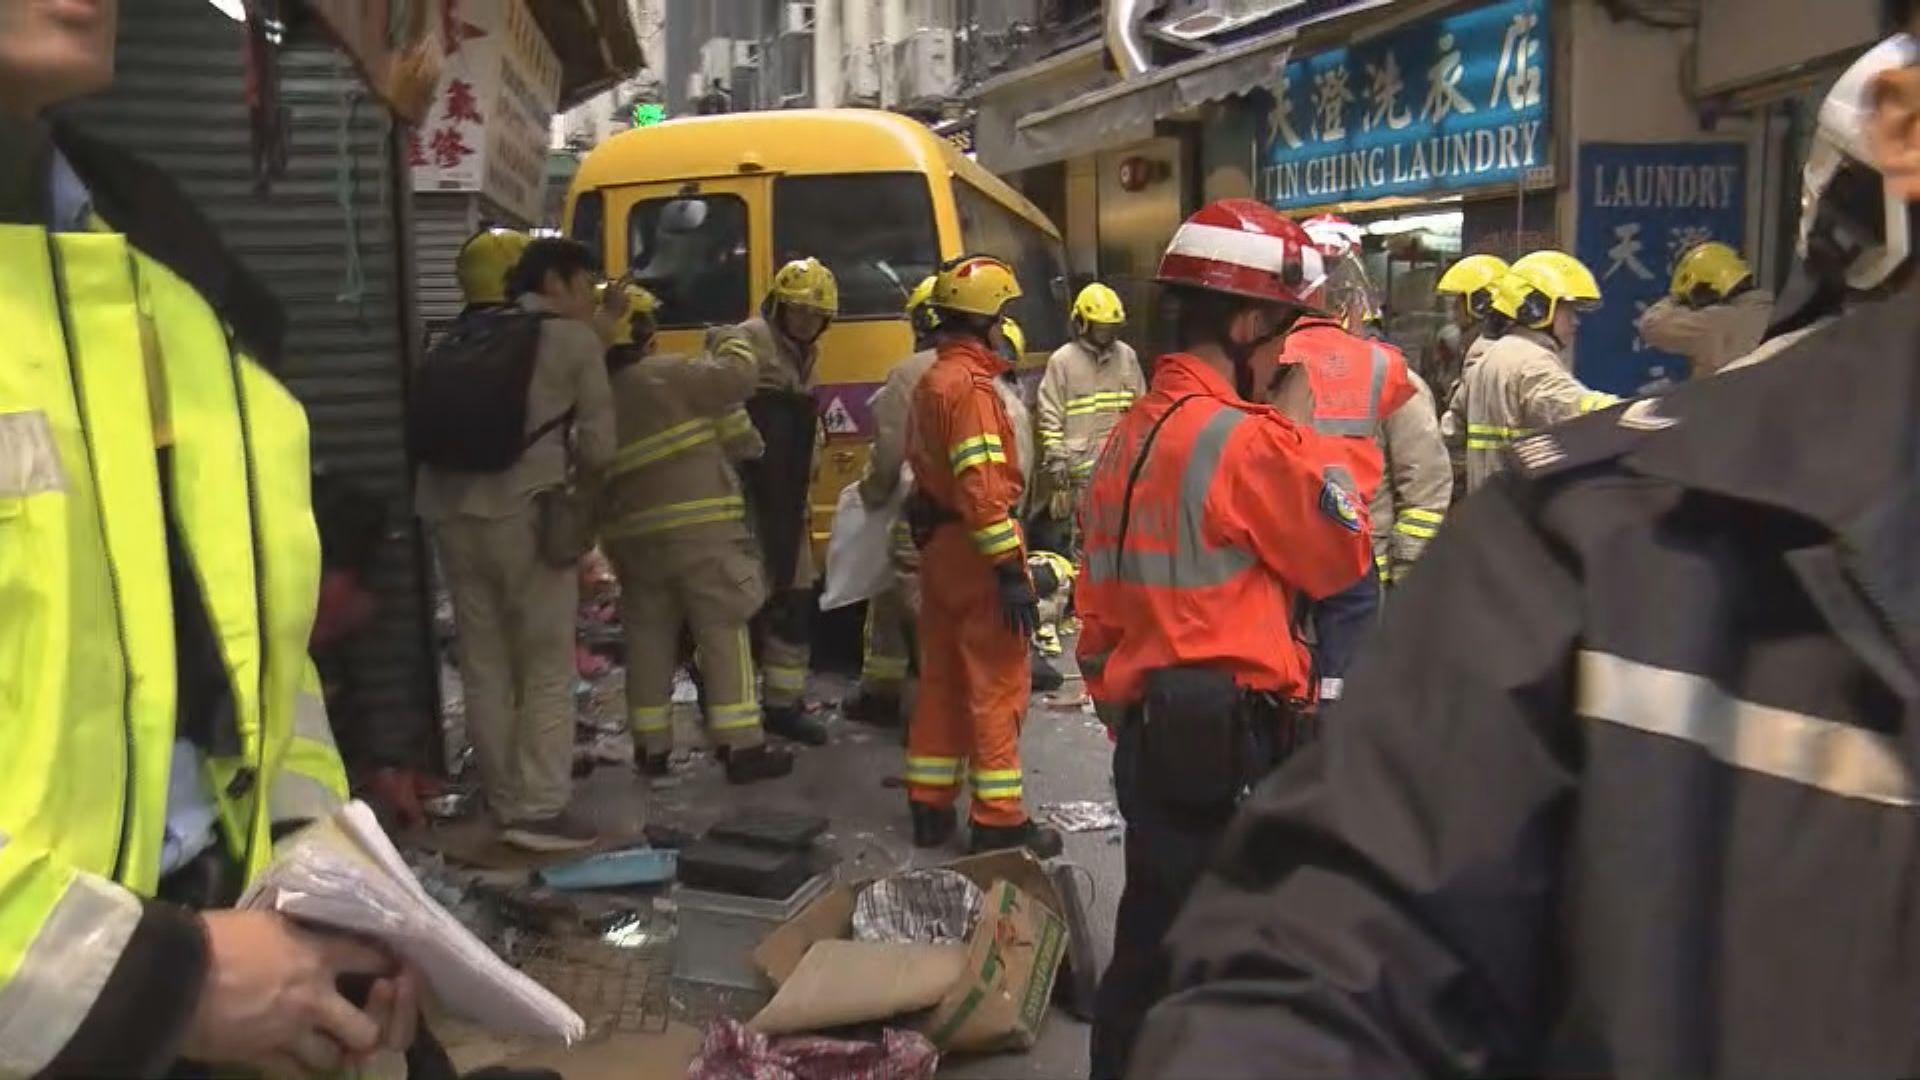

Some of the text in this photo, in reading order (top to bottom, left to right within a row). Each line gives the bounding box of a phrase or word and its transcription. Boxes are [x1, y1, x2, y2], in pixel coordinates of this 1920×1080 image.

[1263, 119, 1541, 201] TIN CHING LAUNDRY
[1593, 164, 1738, 209] LAUNDRY
